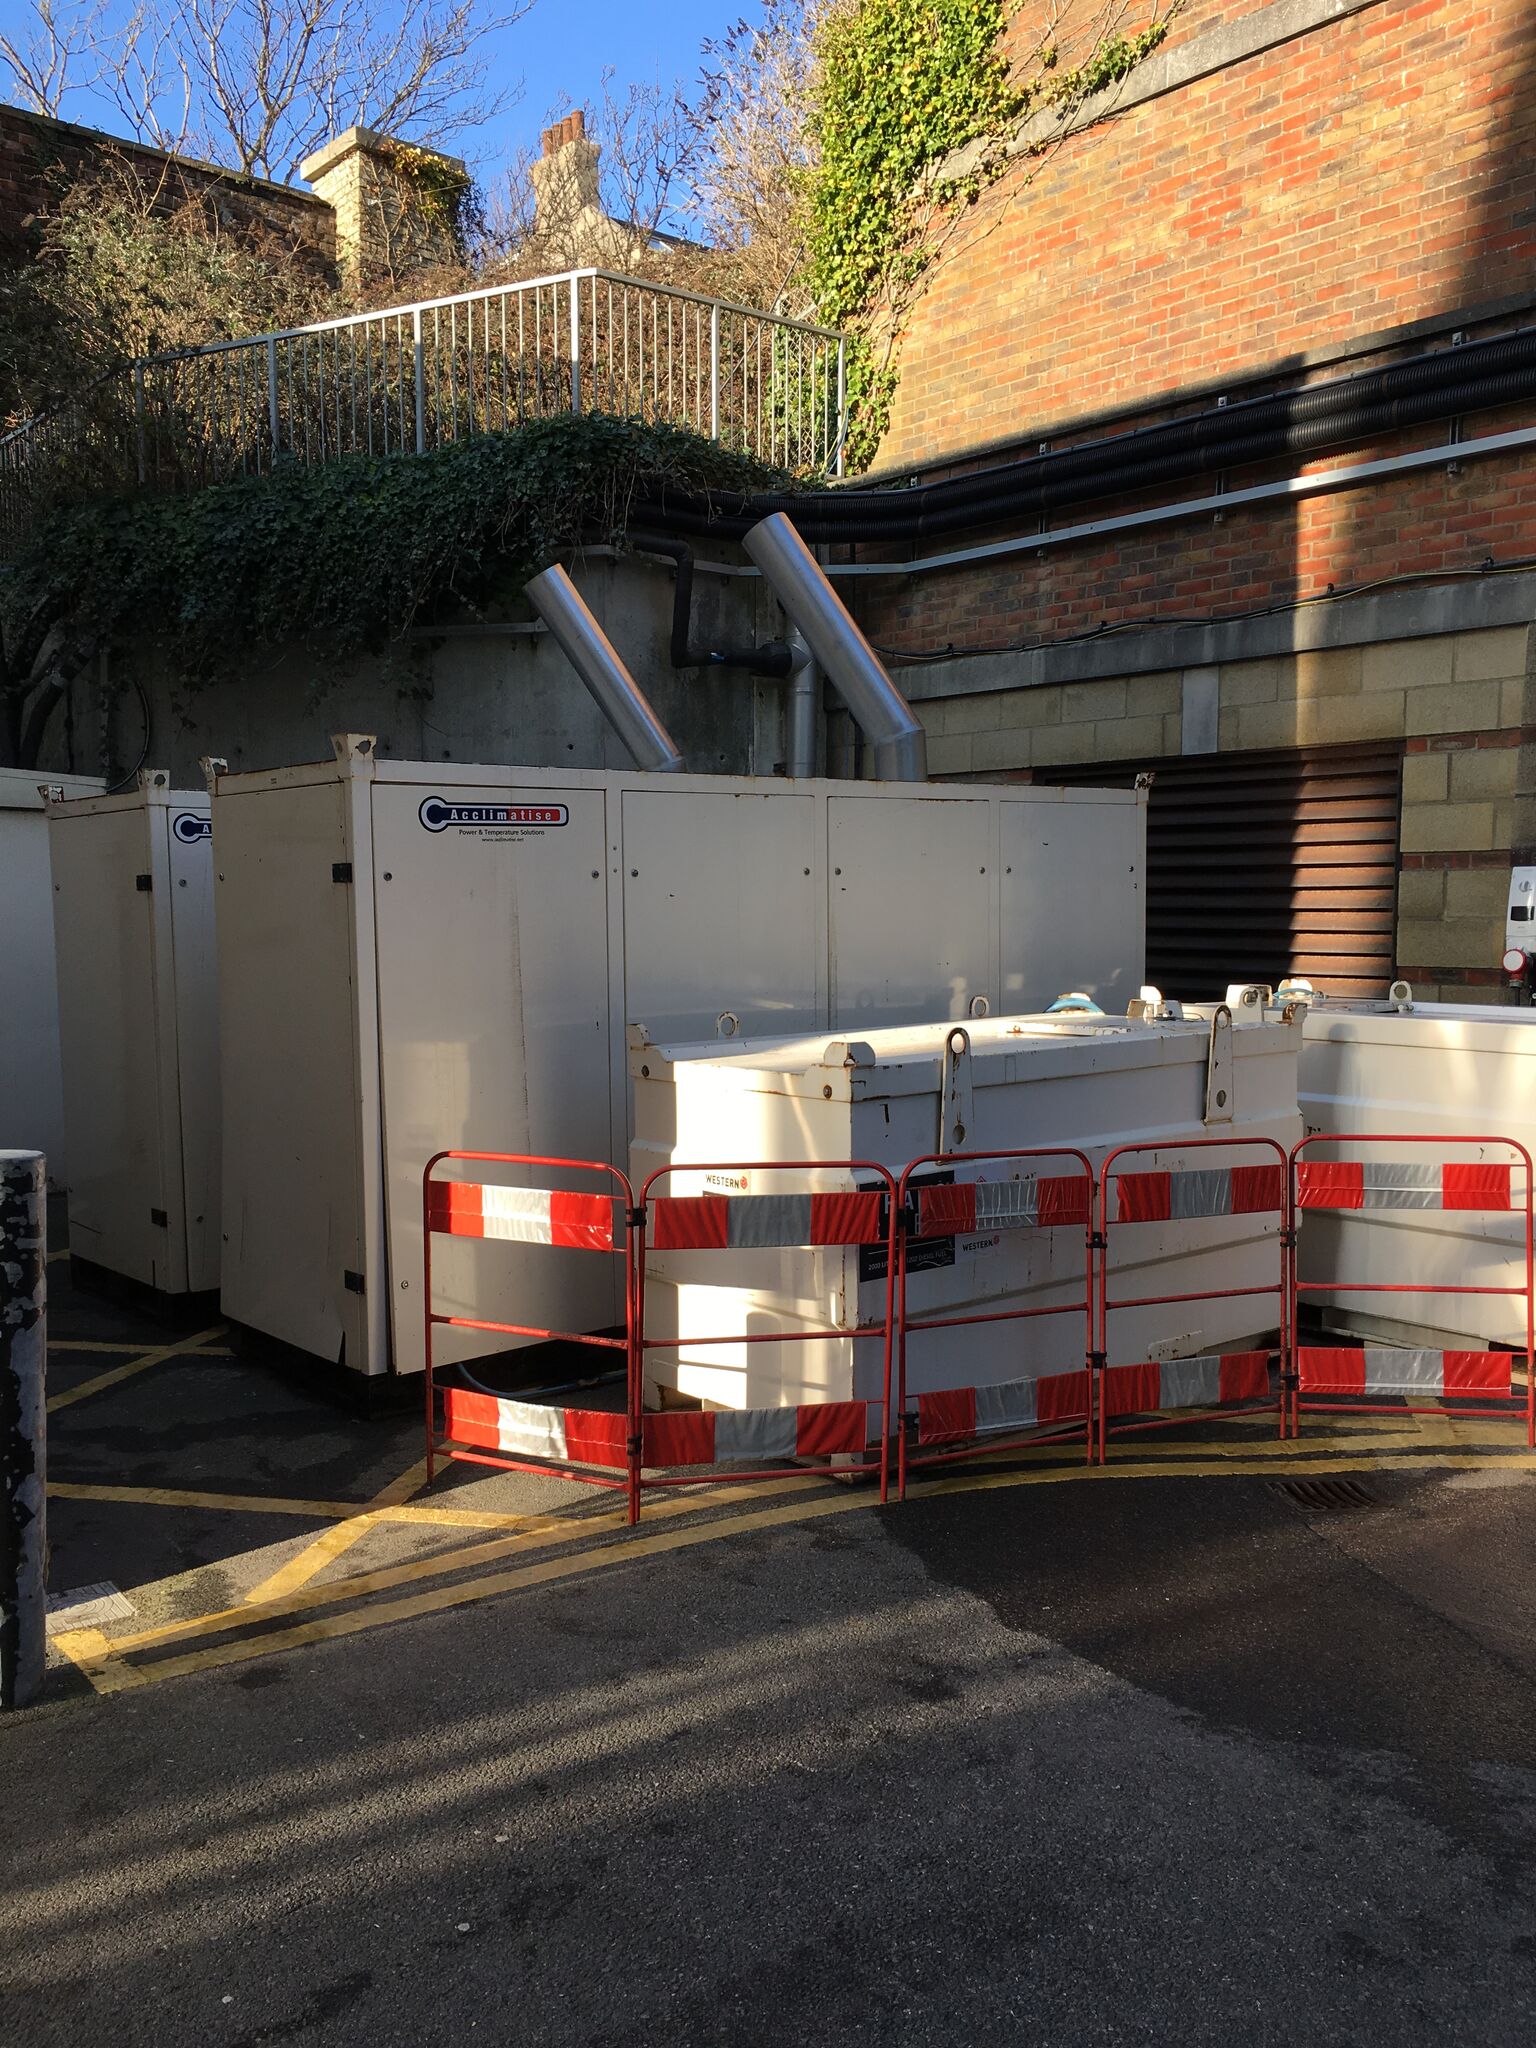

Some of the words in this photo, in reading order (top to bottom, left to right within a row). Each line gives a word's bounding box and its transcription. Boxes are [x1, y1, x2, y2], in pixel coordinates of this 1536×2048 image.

[450, 809, 552, 821] Acclimatise
[484, 829, 520, 837] Temperature
[705, 1174, 740, 1189] WESTERN
[962, 1239, 993, 1252] WESTERN
